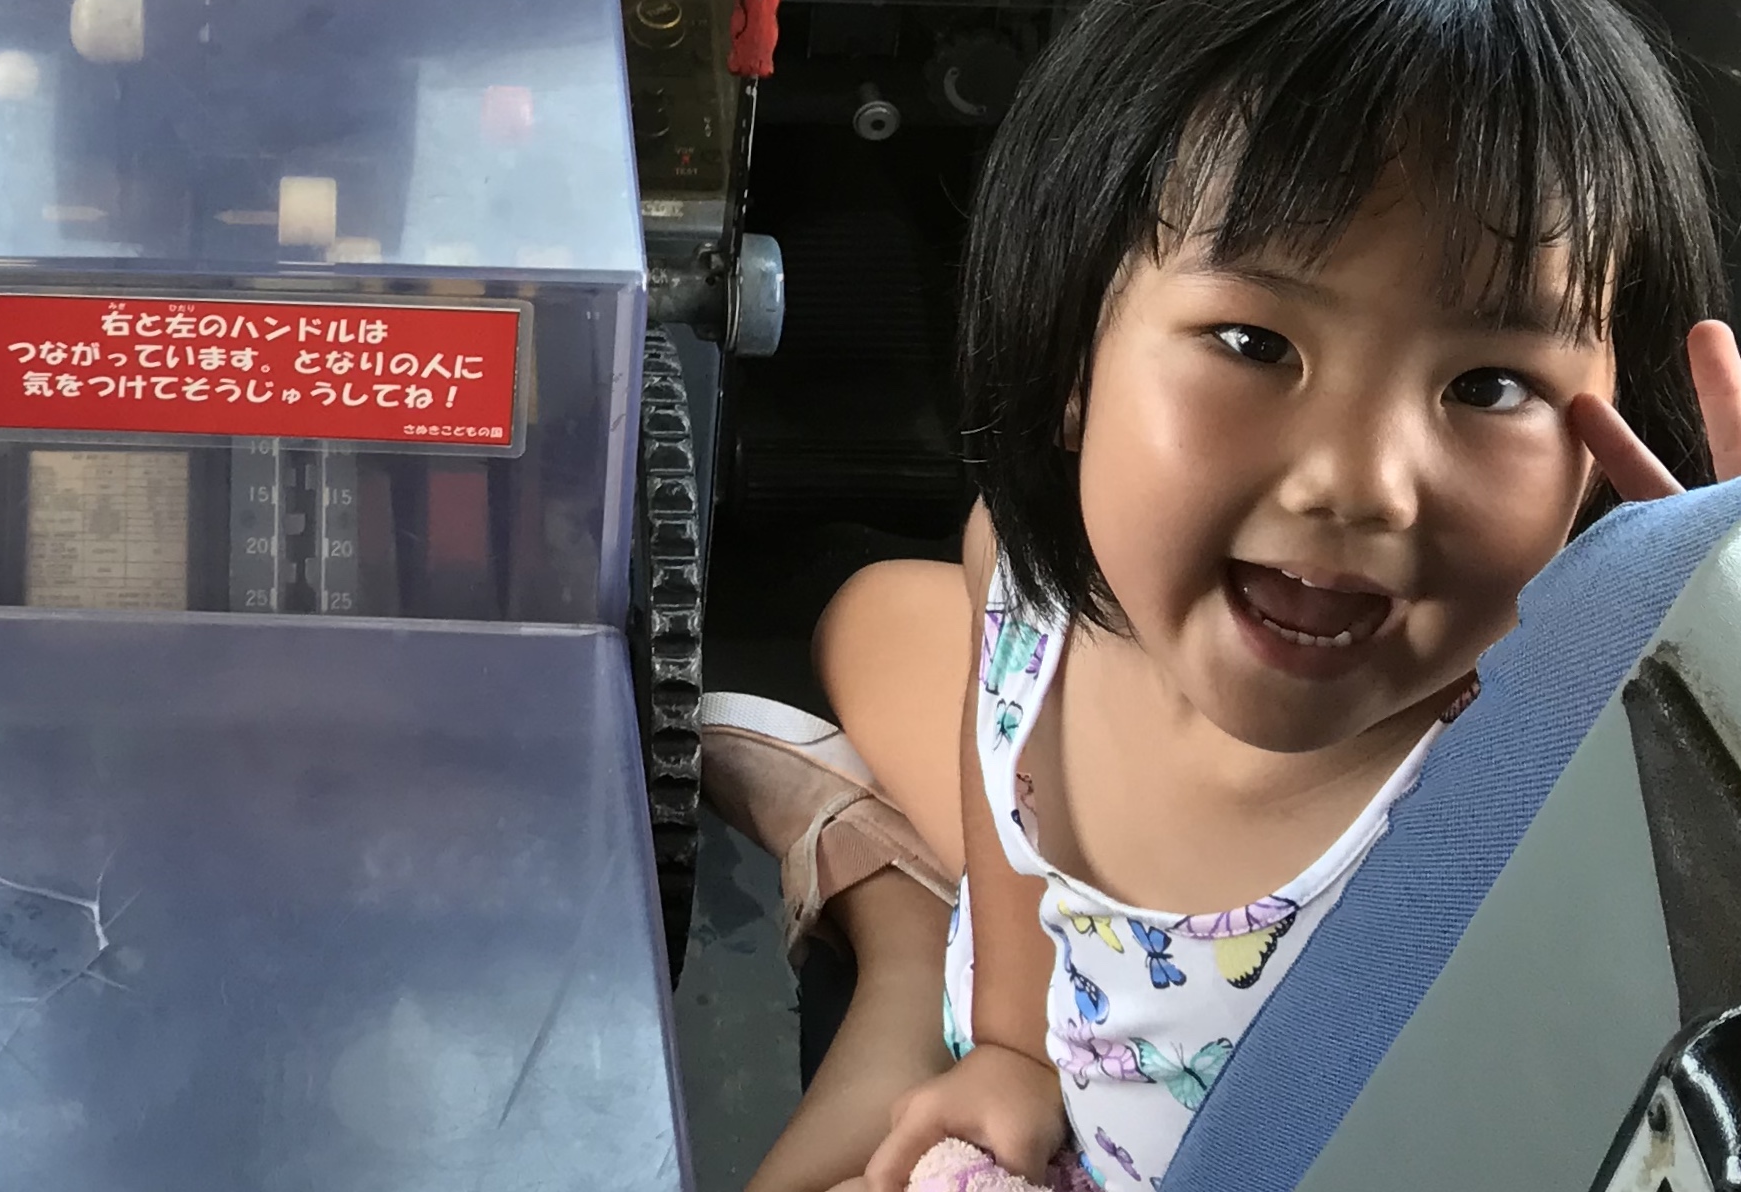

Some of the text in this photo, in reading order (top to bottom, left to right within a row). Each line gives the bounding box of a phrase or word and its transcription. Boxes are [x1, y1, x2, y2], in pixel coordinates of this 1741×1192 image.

[101, 310, 389, 344] 右と左のハンドルは
[8, 341, 484, 379] つながっています。となりの人に
[22, 370, 458, 409] 気をつけてそうじゅうしてね！
[403, 424, 504, 438] さぬきこどもの国
[249, 488, 269, 503] 15
[331, 488, 352, 505] 15
[245, 538, 269, 555] 20
[330, 540, 353, 558] 20
[245, 590, 268, 607] 25
[330, 593, 353, 610] 25
